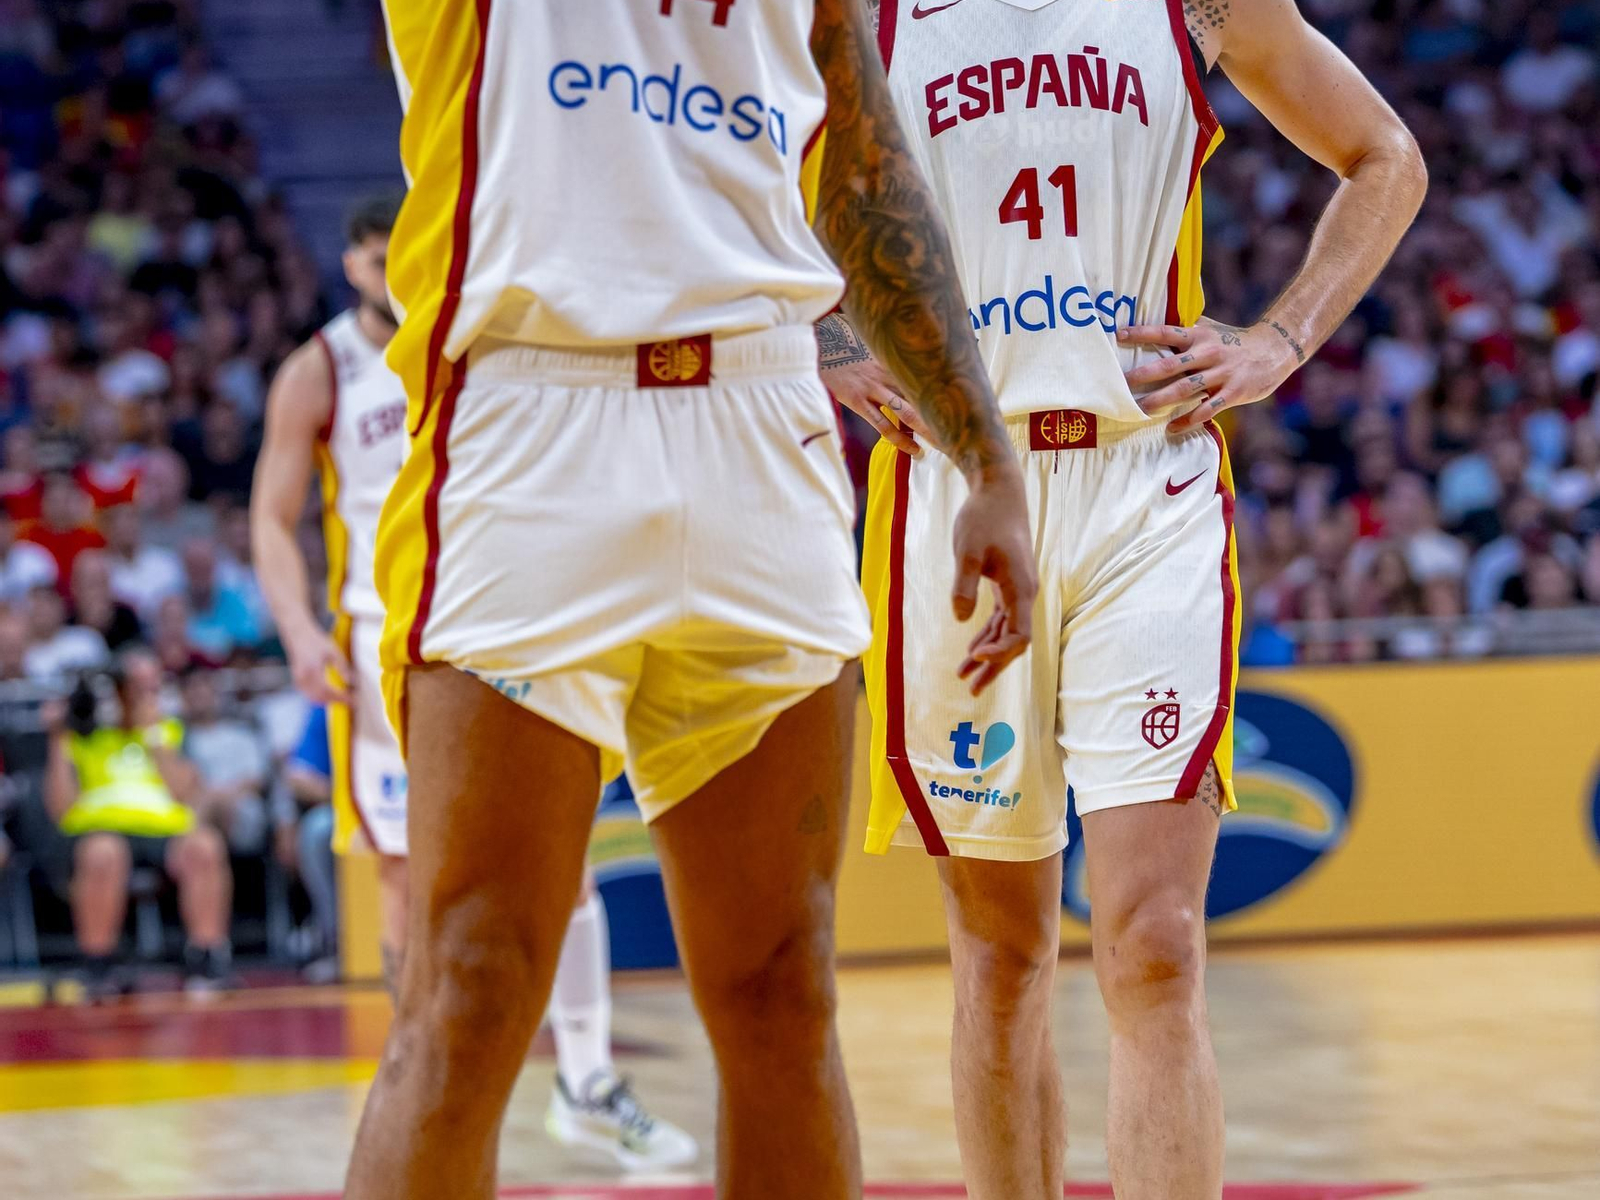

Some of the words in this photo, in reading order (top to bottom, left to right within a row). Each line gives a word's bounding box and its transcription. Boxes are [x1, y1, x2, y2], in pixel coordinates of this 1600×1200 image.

[548, 61, 788, 156] endesa
[925, 45, 1149, 139] ESPAÑA
[998, 164, 1078, 240] 41
[968, 275, 1137, 335] ndesa
[929, 781, 1022, 811] tenerife!
